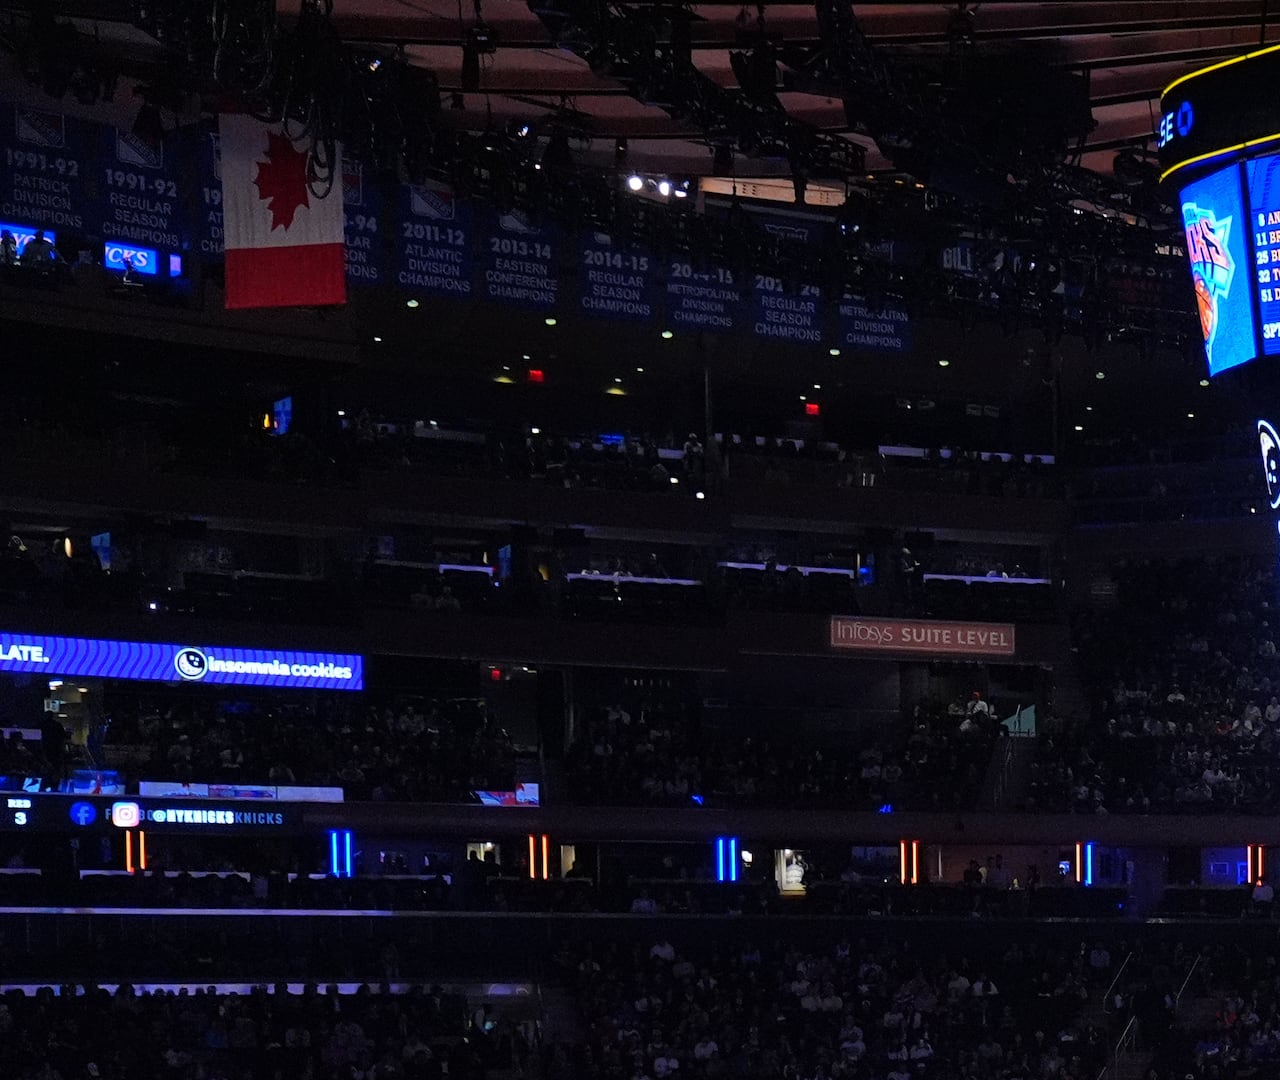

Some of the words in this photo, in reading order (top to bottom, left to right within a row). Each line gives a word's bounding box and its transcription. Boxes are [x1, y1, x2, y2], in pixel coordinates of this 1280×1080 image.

[105, 168, 177, 197] 1991-92
[13, 189, 72, 210] DIVISION
[109, 192, 172, 216] REGULAR
[2, 203, 83, 228] CHAMPIONS
[114, 208, 168, 230] SEASON
[103, 221, 179, 247] CHAMPIONS
[403, 221, 465, 246] 2011-12
[1255, 232, 1267, 246] 11
[405, 243, 464, 263] ATLANTIC
[491, 237, 551, 260] 2013-14
[1256, 251, 1269, 265] 25
[408, 258, 461, 277] DIVISION
[495, 258, 548, 275] EASTERN
[583, 250, 649, 271] 2014-15
[399, 271, 472, 292] CHAMPIONS
[486, 270, 558, 291] CONFERENCE
[589, 270, 644, 288] REGULAR
[1258, 270, 1271, 284] 32
[489, 285, 556, 303] CHAMPIONS
[593, 285, 640, 300] SEASON
[667, 283, 739, 301] METROPOLITAN
[1261, 288, 1273, 302] 51
[582, 297, 650, 316] CHAMPIONS
[682, 299, 725, 313] DIVISION
[761, 295, 816, 313] REGULAR
[673, 311, 733, 327] CHAMPIONS
[765, 310, 812, 325] SEASON
[854, 320, 895, 334] DIVISION
[755, 323, 821, 341] CHAMPIONS
[846, 333, 901, 348] CHAMPIONS
[837, 621, 893, 645] Infosys
[902, 628, 951, 644] SUITE
[957, 631, 1009, 647] LEVEL
[0, 644, 49, 663] LATE.
[208, 655, 290, 677] insomnia
[290, 662, 352, 680] cookies
